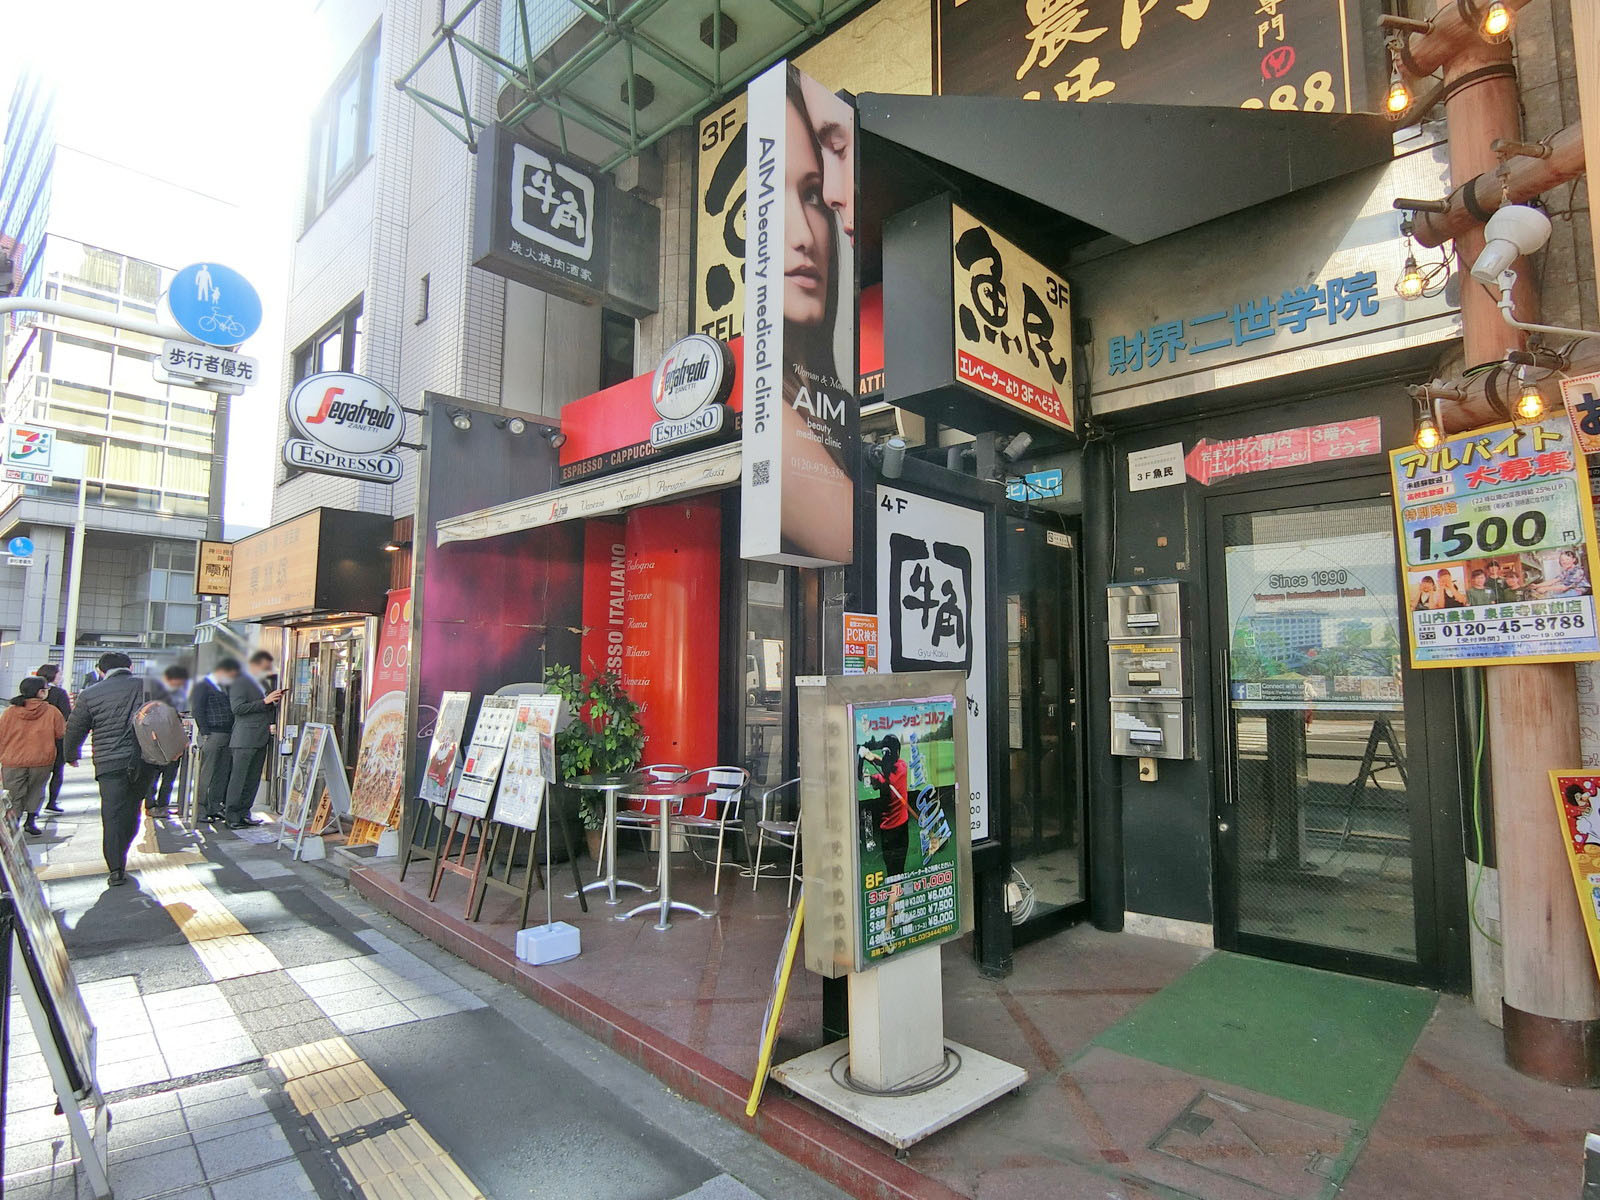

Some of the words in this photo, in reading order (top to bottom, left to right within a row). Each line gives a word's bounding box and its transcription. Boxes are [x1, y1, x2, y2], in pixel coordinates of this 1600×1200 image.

[702, 108, 736, 152] 3F
[759, 137, 775, 199] AIM
[524, 170, 585, 239] 牛角
[755, 200, 774, 278] beauty
[509, 240, 592, 282] 炭火焼肉酒家
[1046, 276, 1068, 309] 3F
[755, 284, 774, 372] medical
[1108, 271, 1380, 376] 財界二世学院
[169, 347, 253, 380] 歩行者優先
[655, 353, 710, 404] Segafredo
[793, 364, 820, 383] Woman
[821, 375, 828, 387] &
[674, 384, 696, 394] ZANETTI
[306, 387, 396, 430] Segafredo
[755, 377, 771, 433] clinic
[792, 385, 847, 426] AIM
[347, 424, 379, 433] ZANETTI
[655, 412, 714, 442] ESPRESSO
[796, 428, 824, 445] medical
[825, 434, 842, 449] clinic
[807, 416, 832, 435] beauty
[300, 445, 393, 474] ESPRESSO
[1328, 439, 1371, 458] どうぞ
[1400, 426, 1562, 478] アルバイト
[563, 458, 603, 479] ESPRESSO
[1464, 451, 1575, 489] 大募集
[881, 494, 908, 514] 4F
[1413, 510, 1547, 561] 1,500
[1562, 530, 1576, 542] 円
[627, 560, 655, 574] Bologna
[1269, 574, 1308, 589] Since
[1311, 570, 1348, 586] 1990
[609, 543, 626, 624] ITALIANO
[626, 590, 653, 601] Firenze
[902, 563, 965, 648] 牛角
[1419, 608, 1475, 625] 山内農場
[627, 618, 647, 629] Roma
[1442, 616, 1585, 637] 0120-45-8788
[626, 646, 650, 657] Milano
[624, 674, 650, 686] Venezia
[865, 871, 884, 889] 8F
